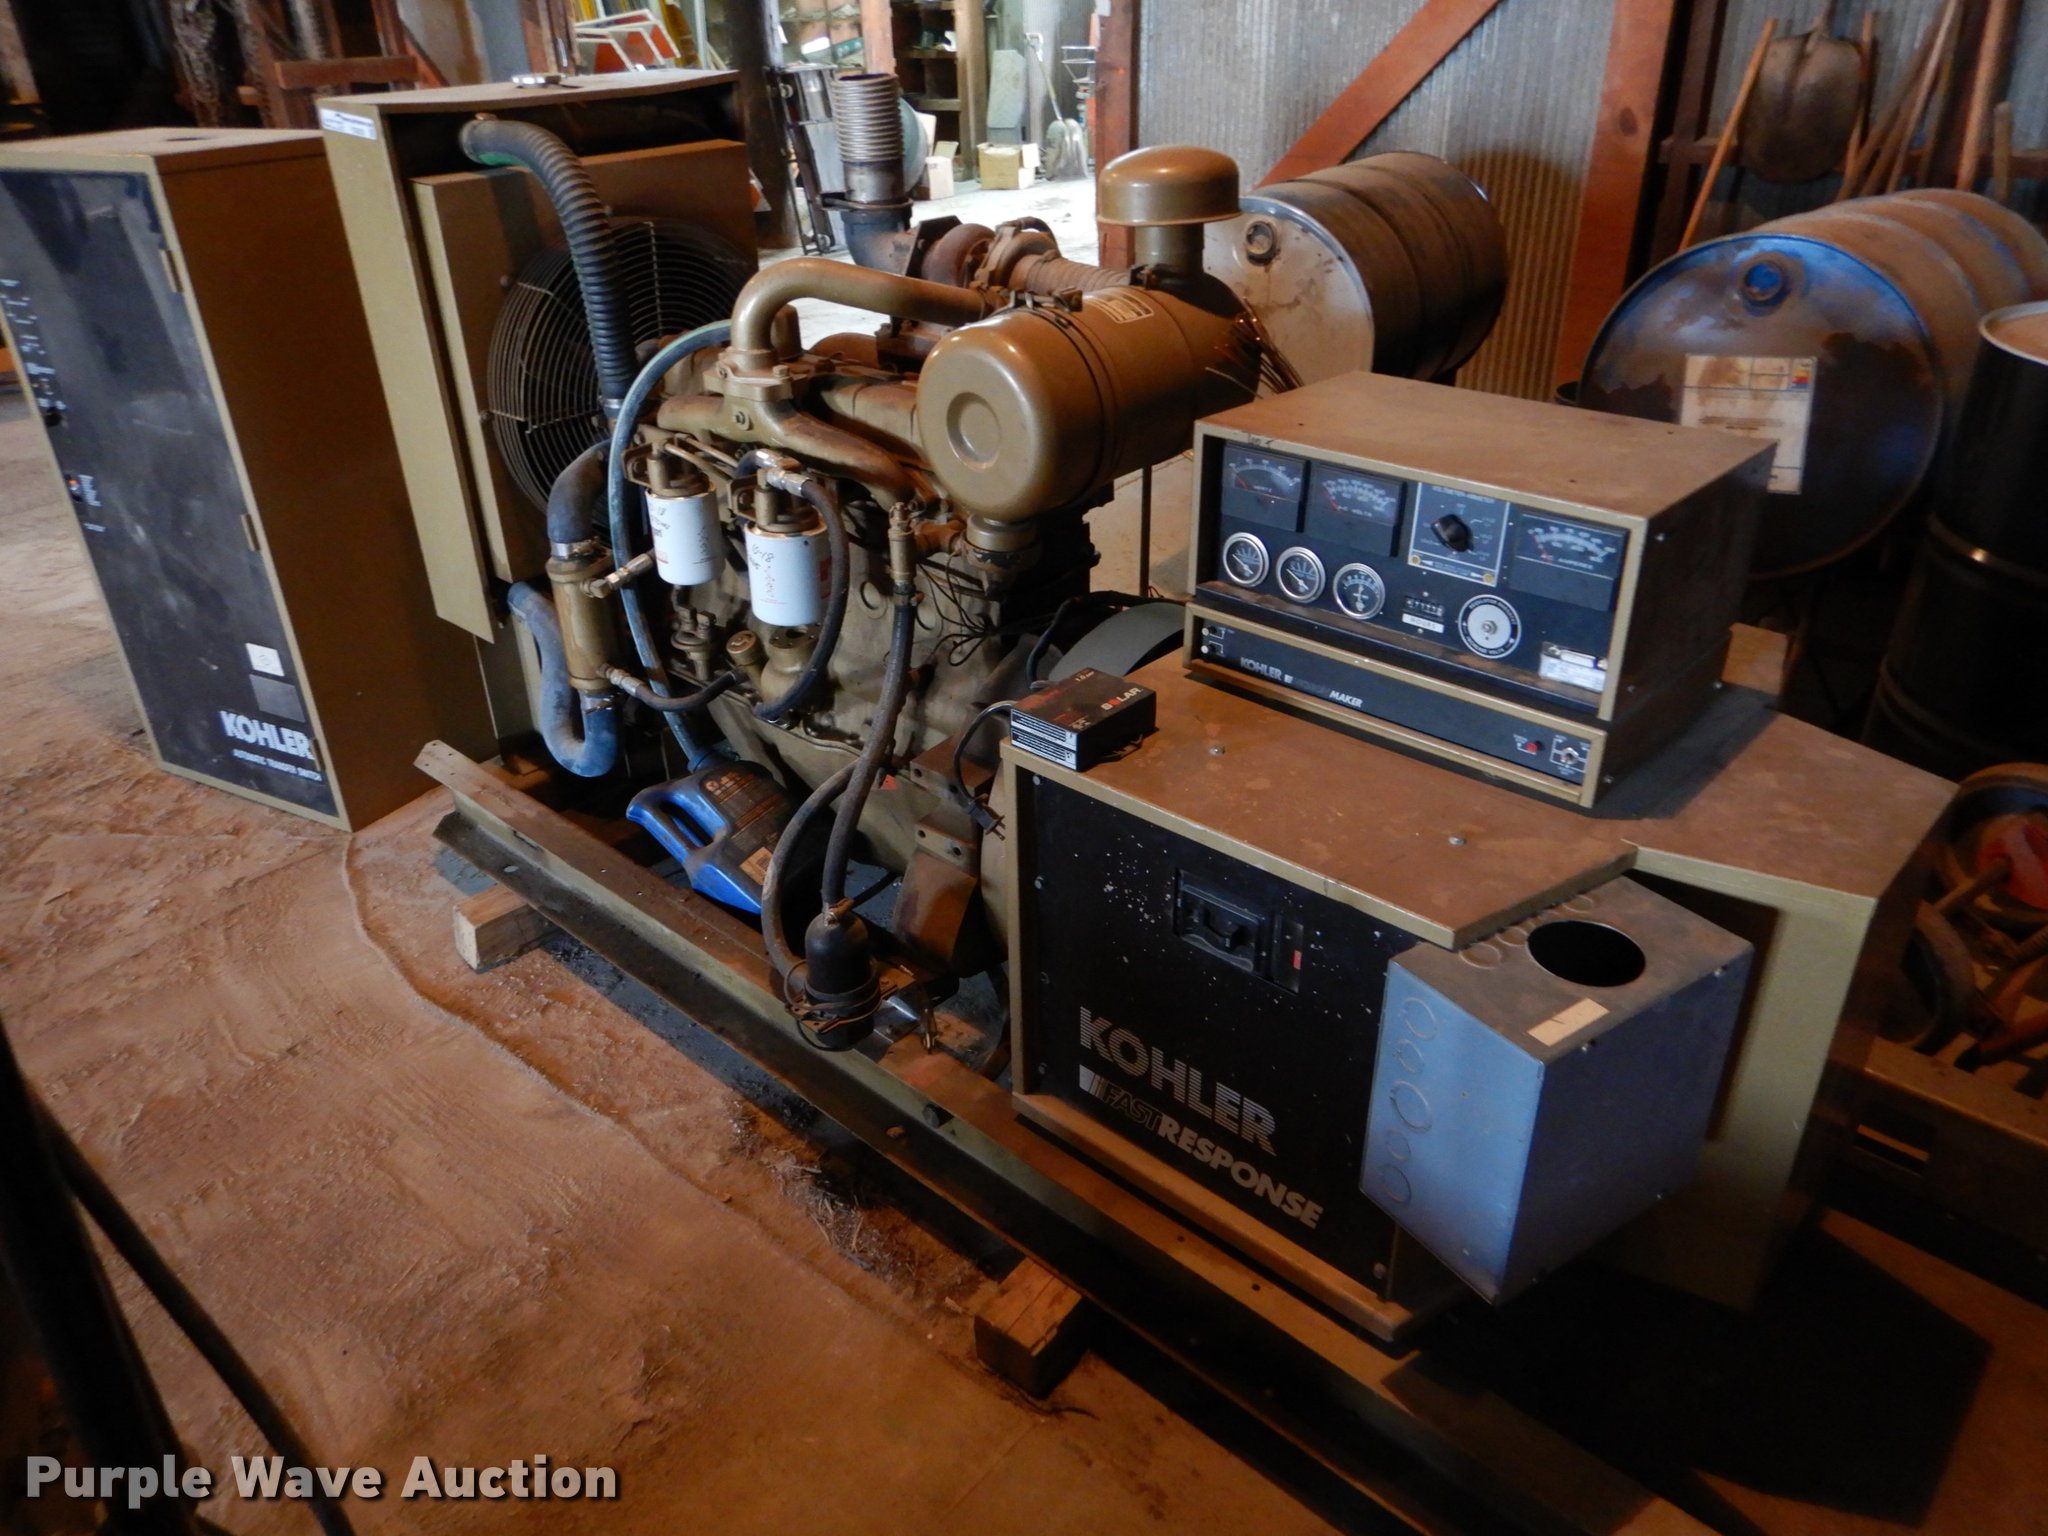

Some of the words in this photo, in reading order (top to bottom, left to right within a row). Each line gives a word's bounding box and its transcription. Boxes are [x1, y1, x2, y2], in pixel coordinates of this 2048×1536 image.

[1240, 657, 1282, 681] KOHLER
[1100, 687, 1142, 711] SOLAR
[1328, 690, 1364, 708] MAKER
[219, 710, 317, 761] KOHLER
[1079, 1005, 1278, 1157] KOHLER
